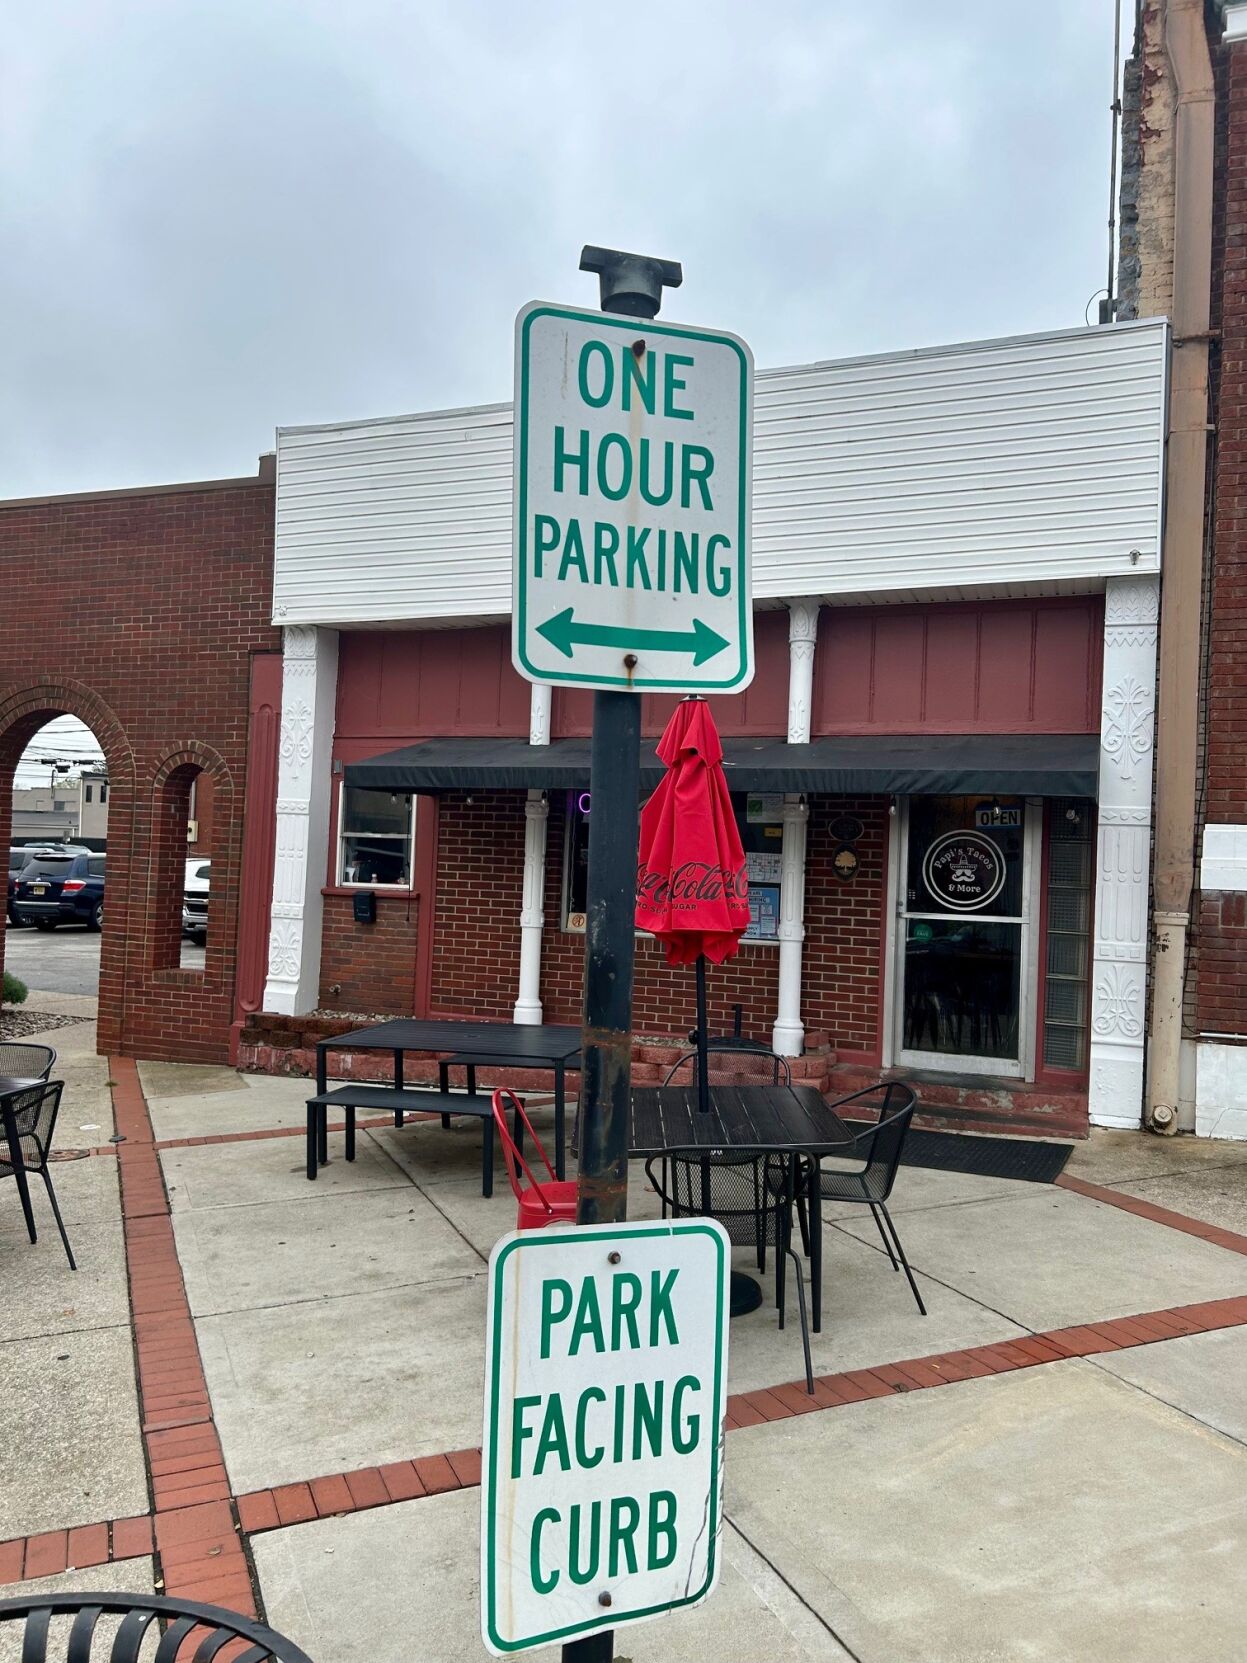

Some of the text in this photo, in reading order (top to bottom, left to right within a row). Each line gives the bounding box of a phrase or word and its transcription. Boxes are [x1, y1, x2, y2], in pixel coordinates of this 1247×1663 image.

[578, 340, 695, 420] ONE
[554, 426, 714, 511] HOUR
[534, 514, 732, 597] PARKING
[934, 847, 993, 870] Papi's Tacos
[980, 810, 1018, 826] OPEN
[957, 884, 981, 892] More
[540, 1268, 680, 1359] PARK
[511, 1375, 701, 1480] FACING
[530, 1490, 678, 1595] CURB
